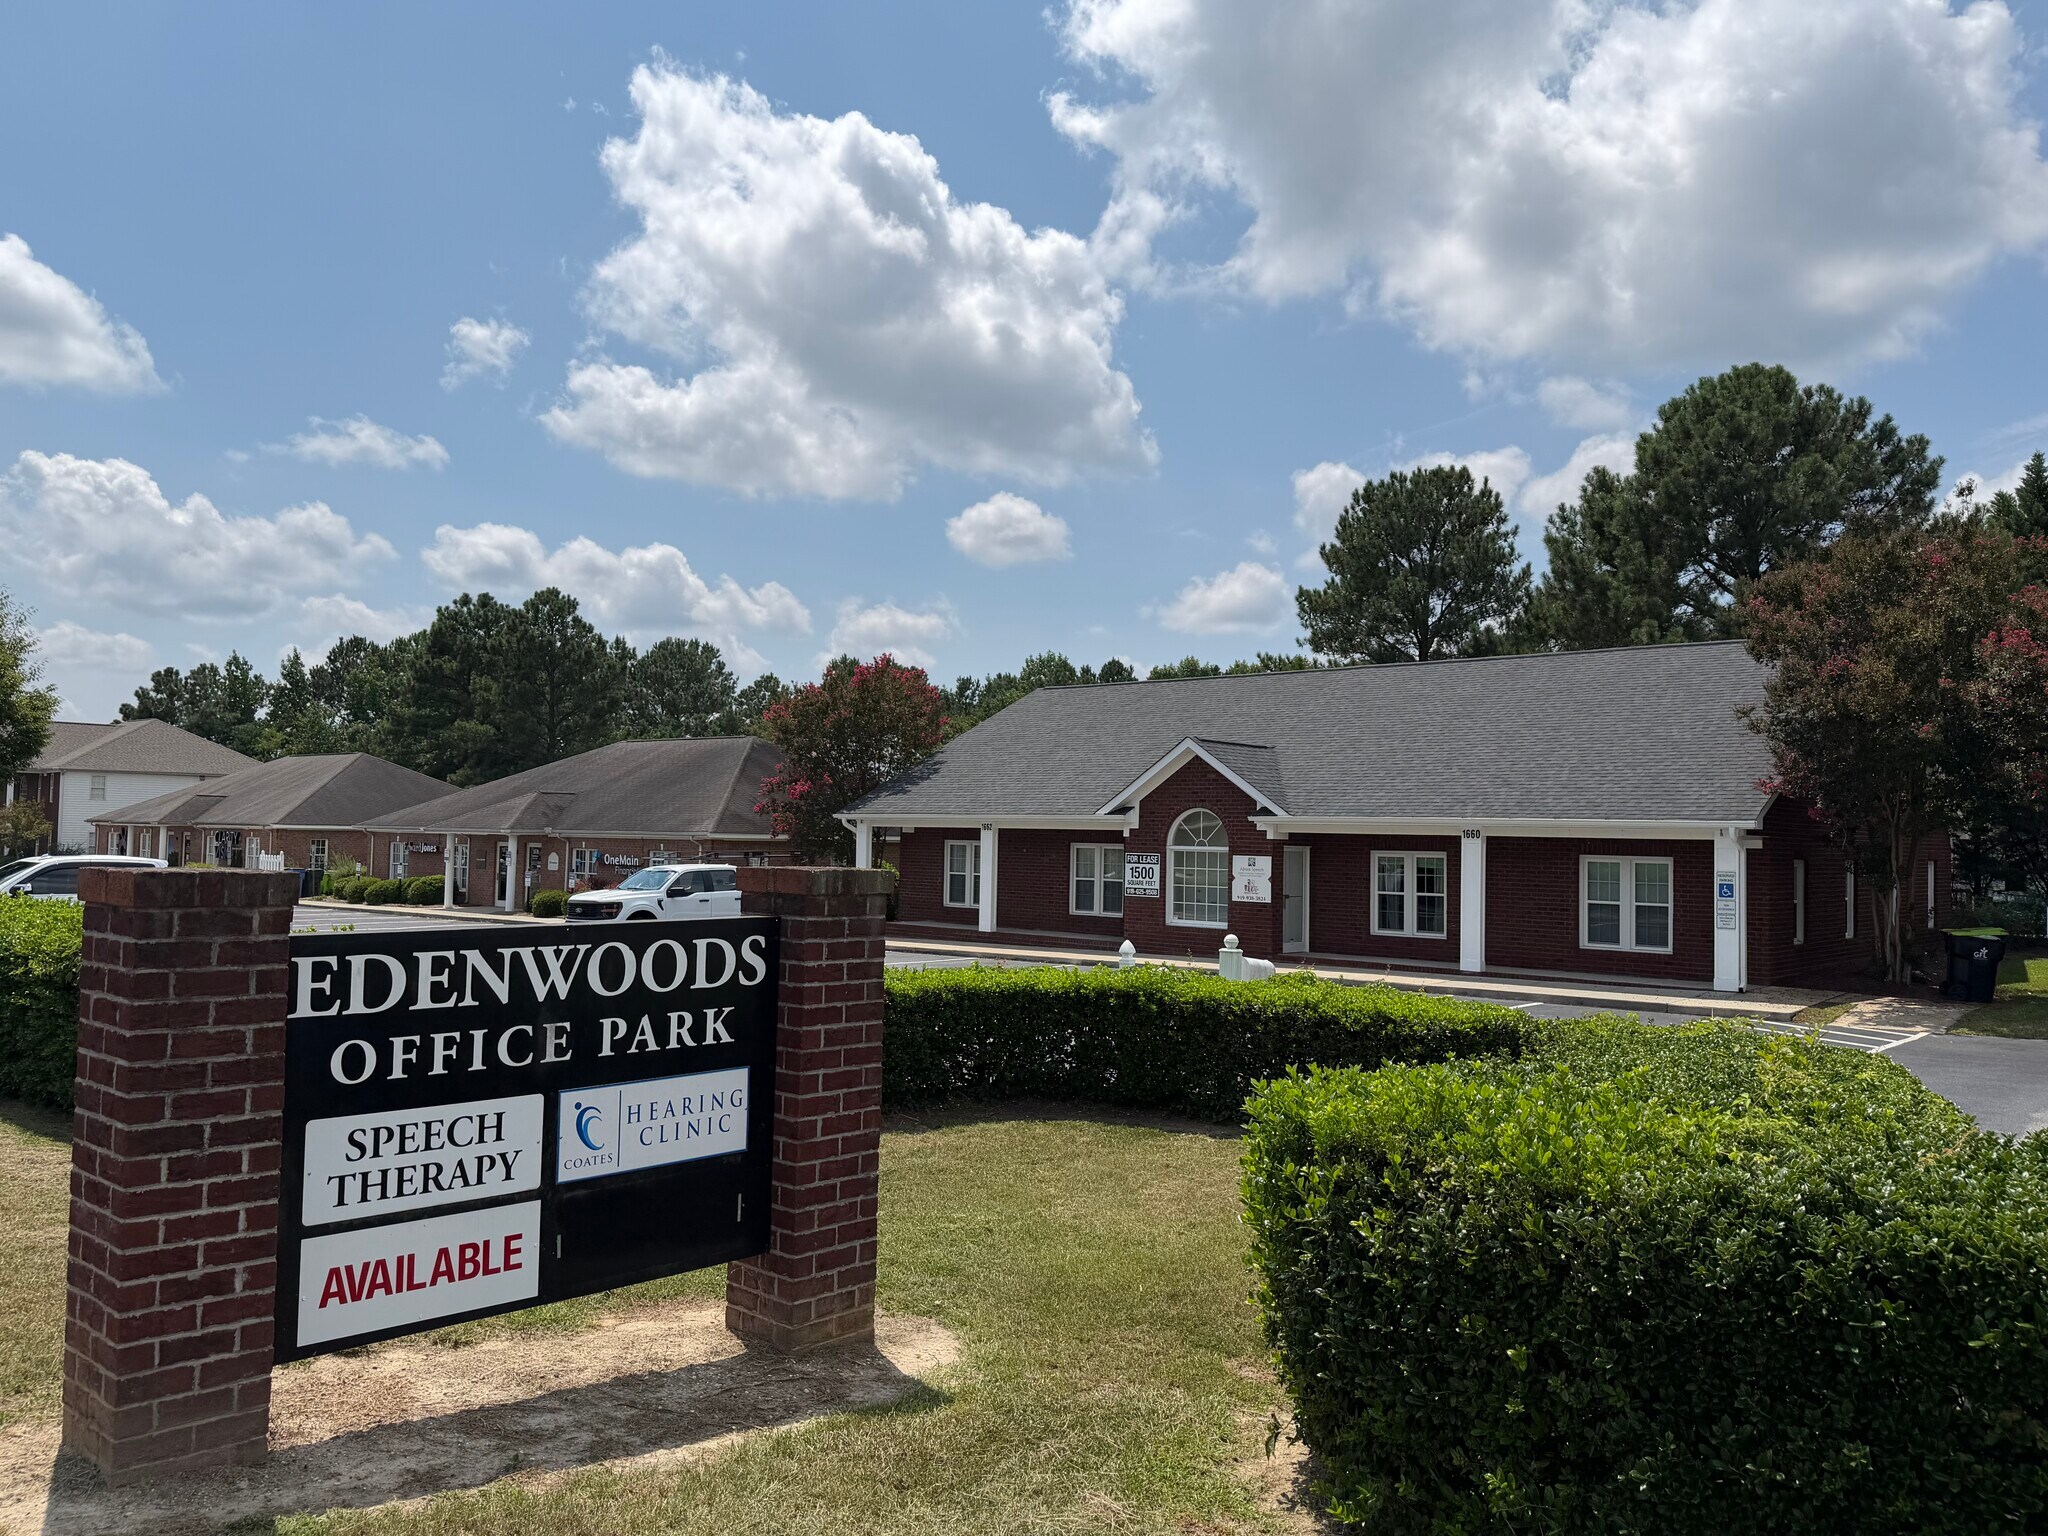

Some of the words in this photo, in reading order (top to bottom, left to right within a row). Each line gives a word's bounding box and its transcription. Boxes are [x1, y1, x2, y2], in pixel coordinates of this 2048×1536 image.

[1462, 829, 1481, 839] 1660
[604, 853, 639, 866] OneMain
[1127, 855, 1139, 863] FOR
[1140, 855, 1158, 864] LEASE
[1129, 866, 1155, 880] 1500
[286, 935, 768, 1020] EDENWOODS
[329, 1022, 573, 1085] OFFICE
[597, 1006, 736, 1057] PARK
[626, 1088, 744, 1125] HEARING
[344, 1111, 507, 1163] SPEECH
[639, 1113, 732, 1147] CLINIC
[326, 1149, 524, 1208] THERAPY
[563, 1152, 614, 1170] COATES
[318, 1232, 524, 1310] AVAILABLE
